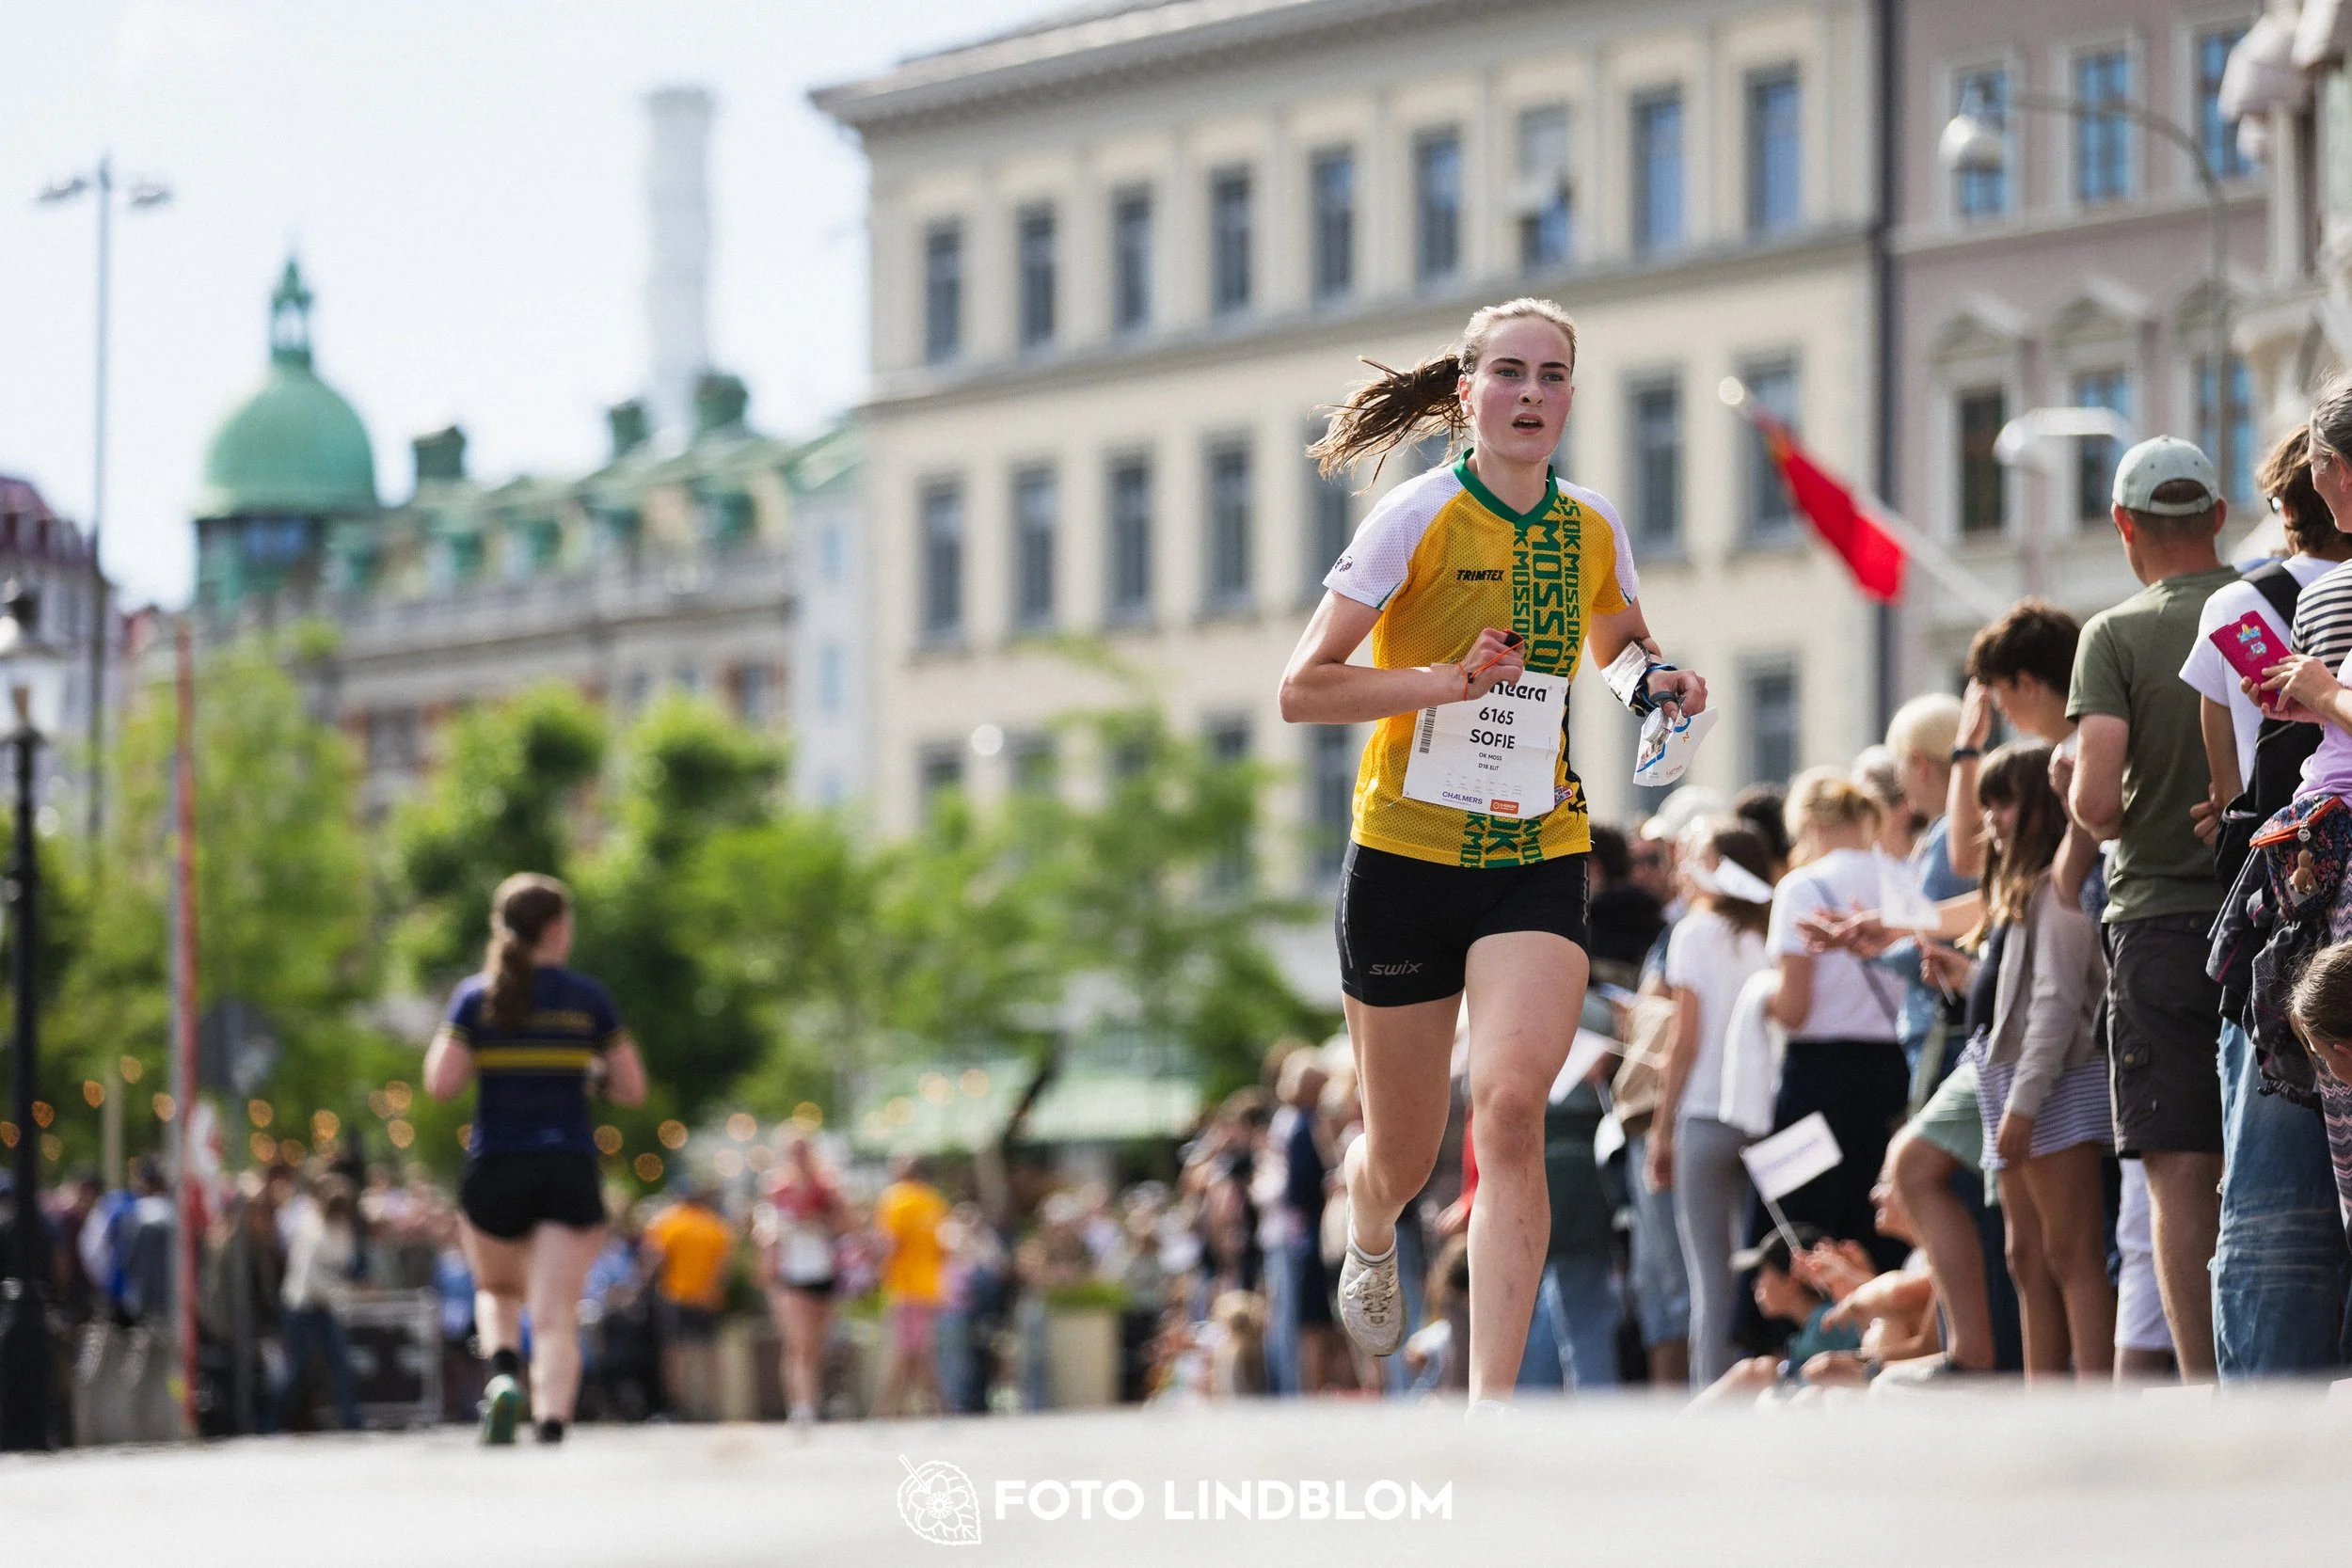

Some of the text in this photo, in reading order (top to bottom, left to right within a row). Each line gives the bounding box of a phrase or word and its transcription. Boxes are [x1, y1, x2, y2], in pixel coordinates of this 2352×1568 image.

[1456, 569, 1505, 581] TRIMTEX
[1479, 706, 1515, 726] 6165
[1469, 728, 1516, 750] SOFIE
[1487, 753, 1503, 762] MOSS
[1441, 791, 1484, 805] CHALMERS
